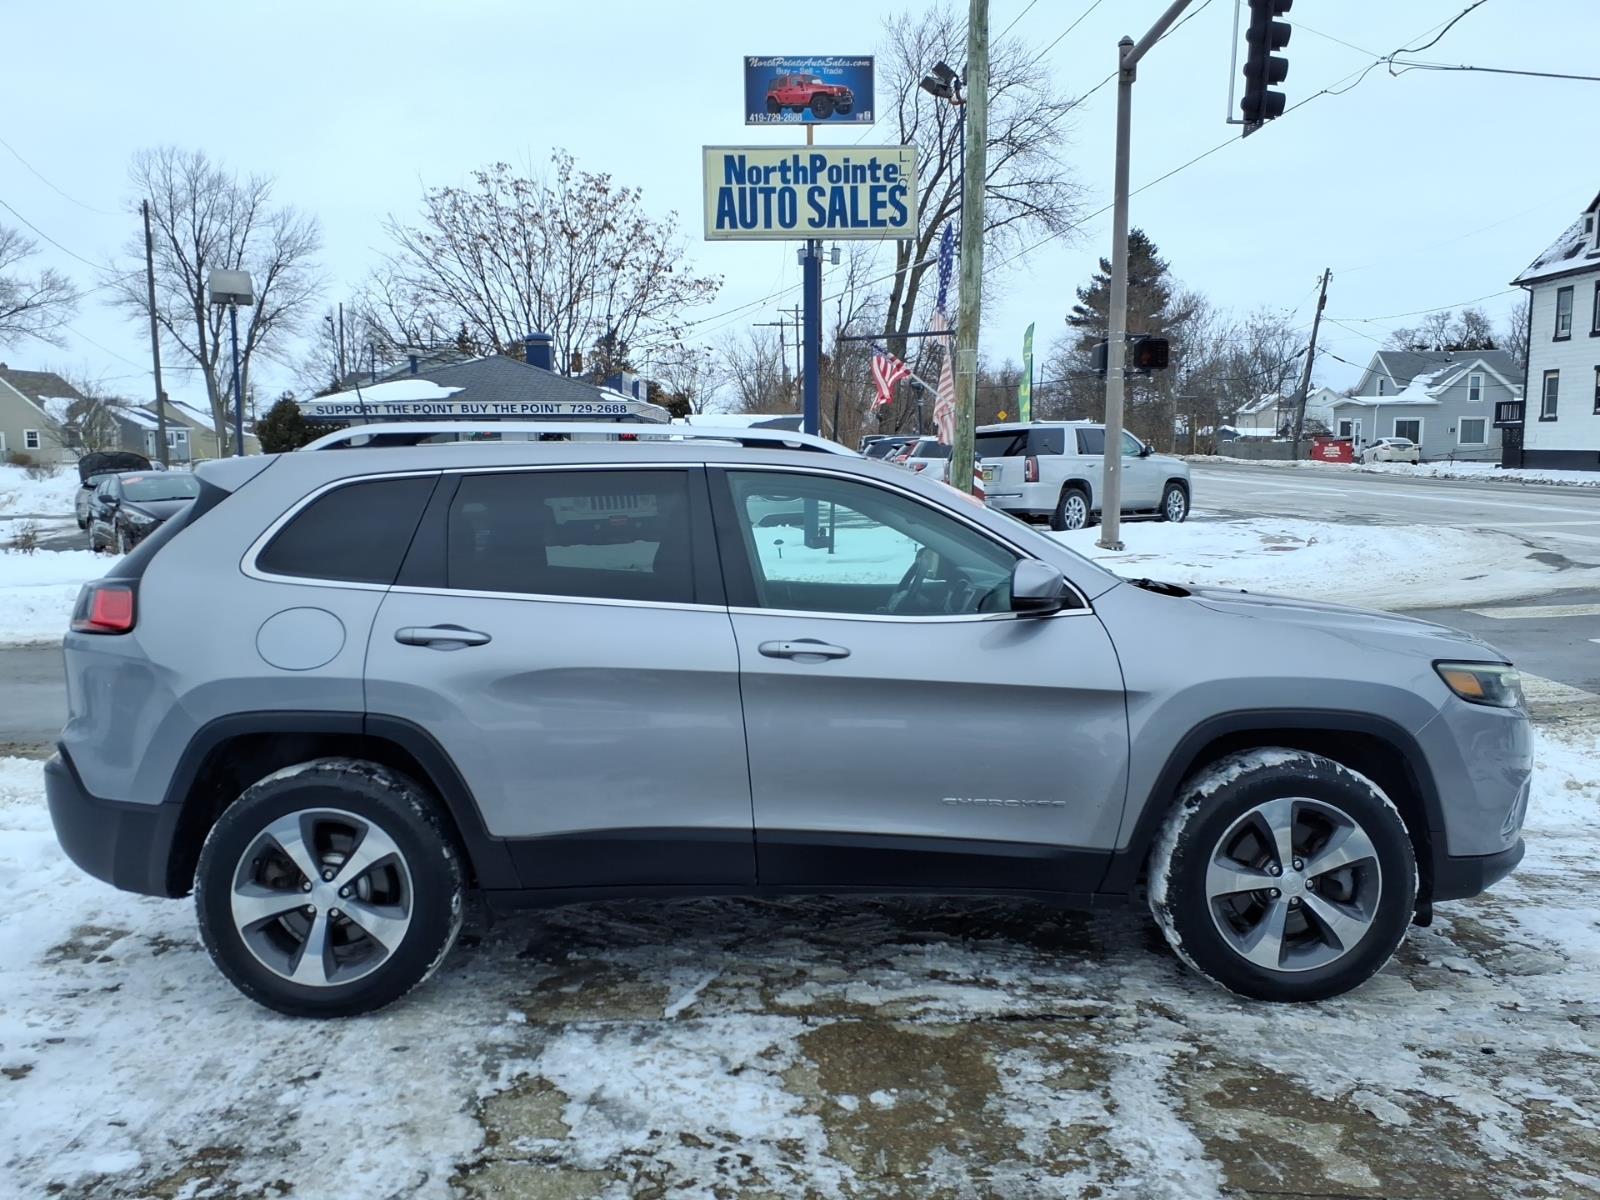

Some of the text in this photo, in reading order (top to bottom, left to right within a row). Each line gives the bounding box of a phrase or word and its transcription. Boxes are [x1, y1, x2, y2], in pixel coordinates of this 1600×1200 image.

[748, 57, 870, 67] NorthPointeAutoSales.com
[776, 67, 791, 75] Buy
[823, 67, 843, 75] Trade
[724, 153, 898, 185] NorthPointe
[716, 184, 908, 229] AUTO SALES
[316, 403, 627, 415] SUPPORT THE POINT BUY THE POINT 729-2688
